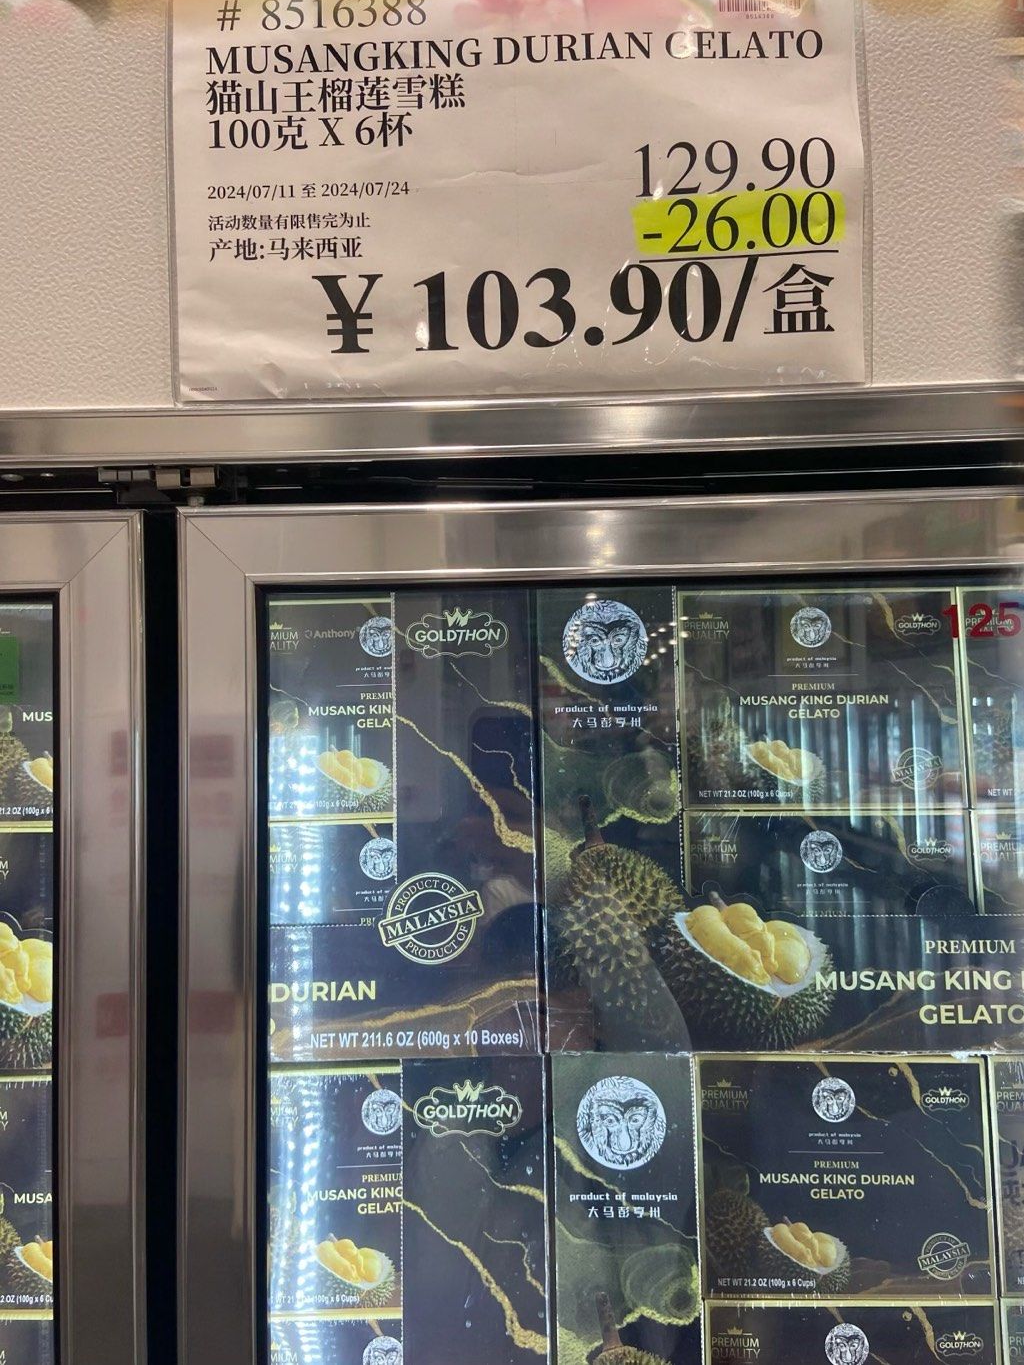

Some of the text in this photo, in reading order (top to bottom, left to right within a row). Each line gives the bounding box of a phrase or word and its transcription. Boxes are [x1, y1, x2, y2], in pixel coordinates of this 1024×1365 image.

[205, 29, 823, 75] MUSANGKING DURIAN GELATO
[206, 73, 466, 115] 猫山王榴莲雪糕
[208, 111, 413, 151] 100克 X 6杯
[634, 136, 836, 198] 129.90
[207, 181, 410, 201] 2024/07/11 至 2024/07/24
[207, 212, 371, 231] 活动数量有限售完为止
[642, 190, 836, 253] -26.00
[209, 236, 363, 262] 产地:马来西亚
[311, 254, 836, 354] ¥ 103.90/盒
[313, 628, 357, 639] Anthony
[414, 628, 501, 646] GOLDTHON
[792, 683, 835, 691] PREMIUM
[739, 694, 889, 707] MUSANG KING DURIAN
[308, 704, 366, 717] MUSANG
[555, 704, 658, 714] product of malaysia
[788, 708, 841, 720] GELATO
[572, 717, 642, 728] 大马彭亨州
[699, 790, 711, 798] NET
[395, 879, 457, 913] PRODUCT OF
[386, 899, 477, 940] MALAYSIA
[457, 925, 469, 944] OF
[405, 940, 457, 959] PRODUCT
[925, 940, 1016, 955] PREMIUM
[815, 970, 1015, 992] MUSANG KING
[271, 980, 377, 1004] DURIAN
[310, 1029, 524, 1050] NET WT 211.6 OZ (600g 10 Boxes)
[701, 1089, 748, 1099] PREMIUM
[924, 1095, 966, 1106] GOLDTHON
[423, 1104, 513, 1123] GOLDTHON
[814, 1160, 859, 1170] PREMIUM
[759, 1173, 915, 1185] MUSANG KING DURIAN
[307, 1187, 367, 1201] MUSANG
[569, 1191, 678, 1202] product of malaysia
[810, 1188, 865, 1200] GELATO
[588, 1206, 661, 1219] 大马彭亨州
[717, 1278, 767, 1287] NET WT 21.2 OZ
[711, 1337, 760, 1348] PREMIUM
